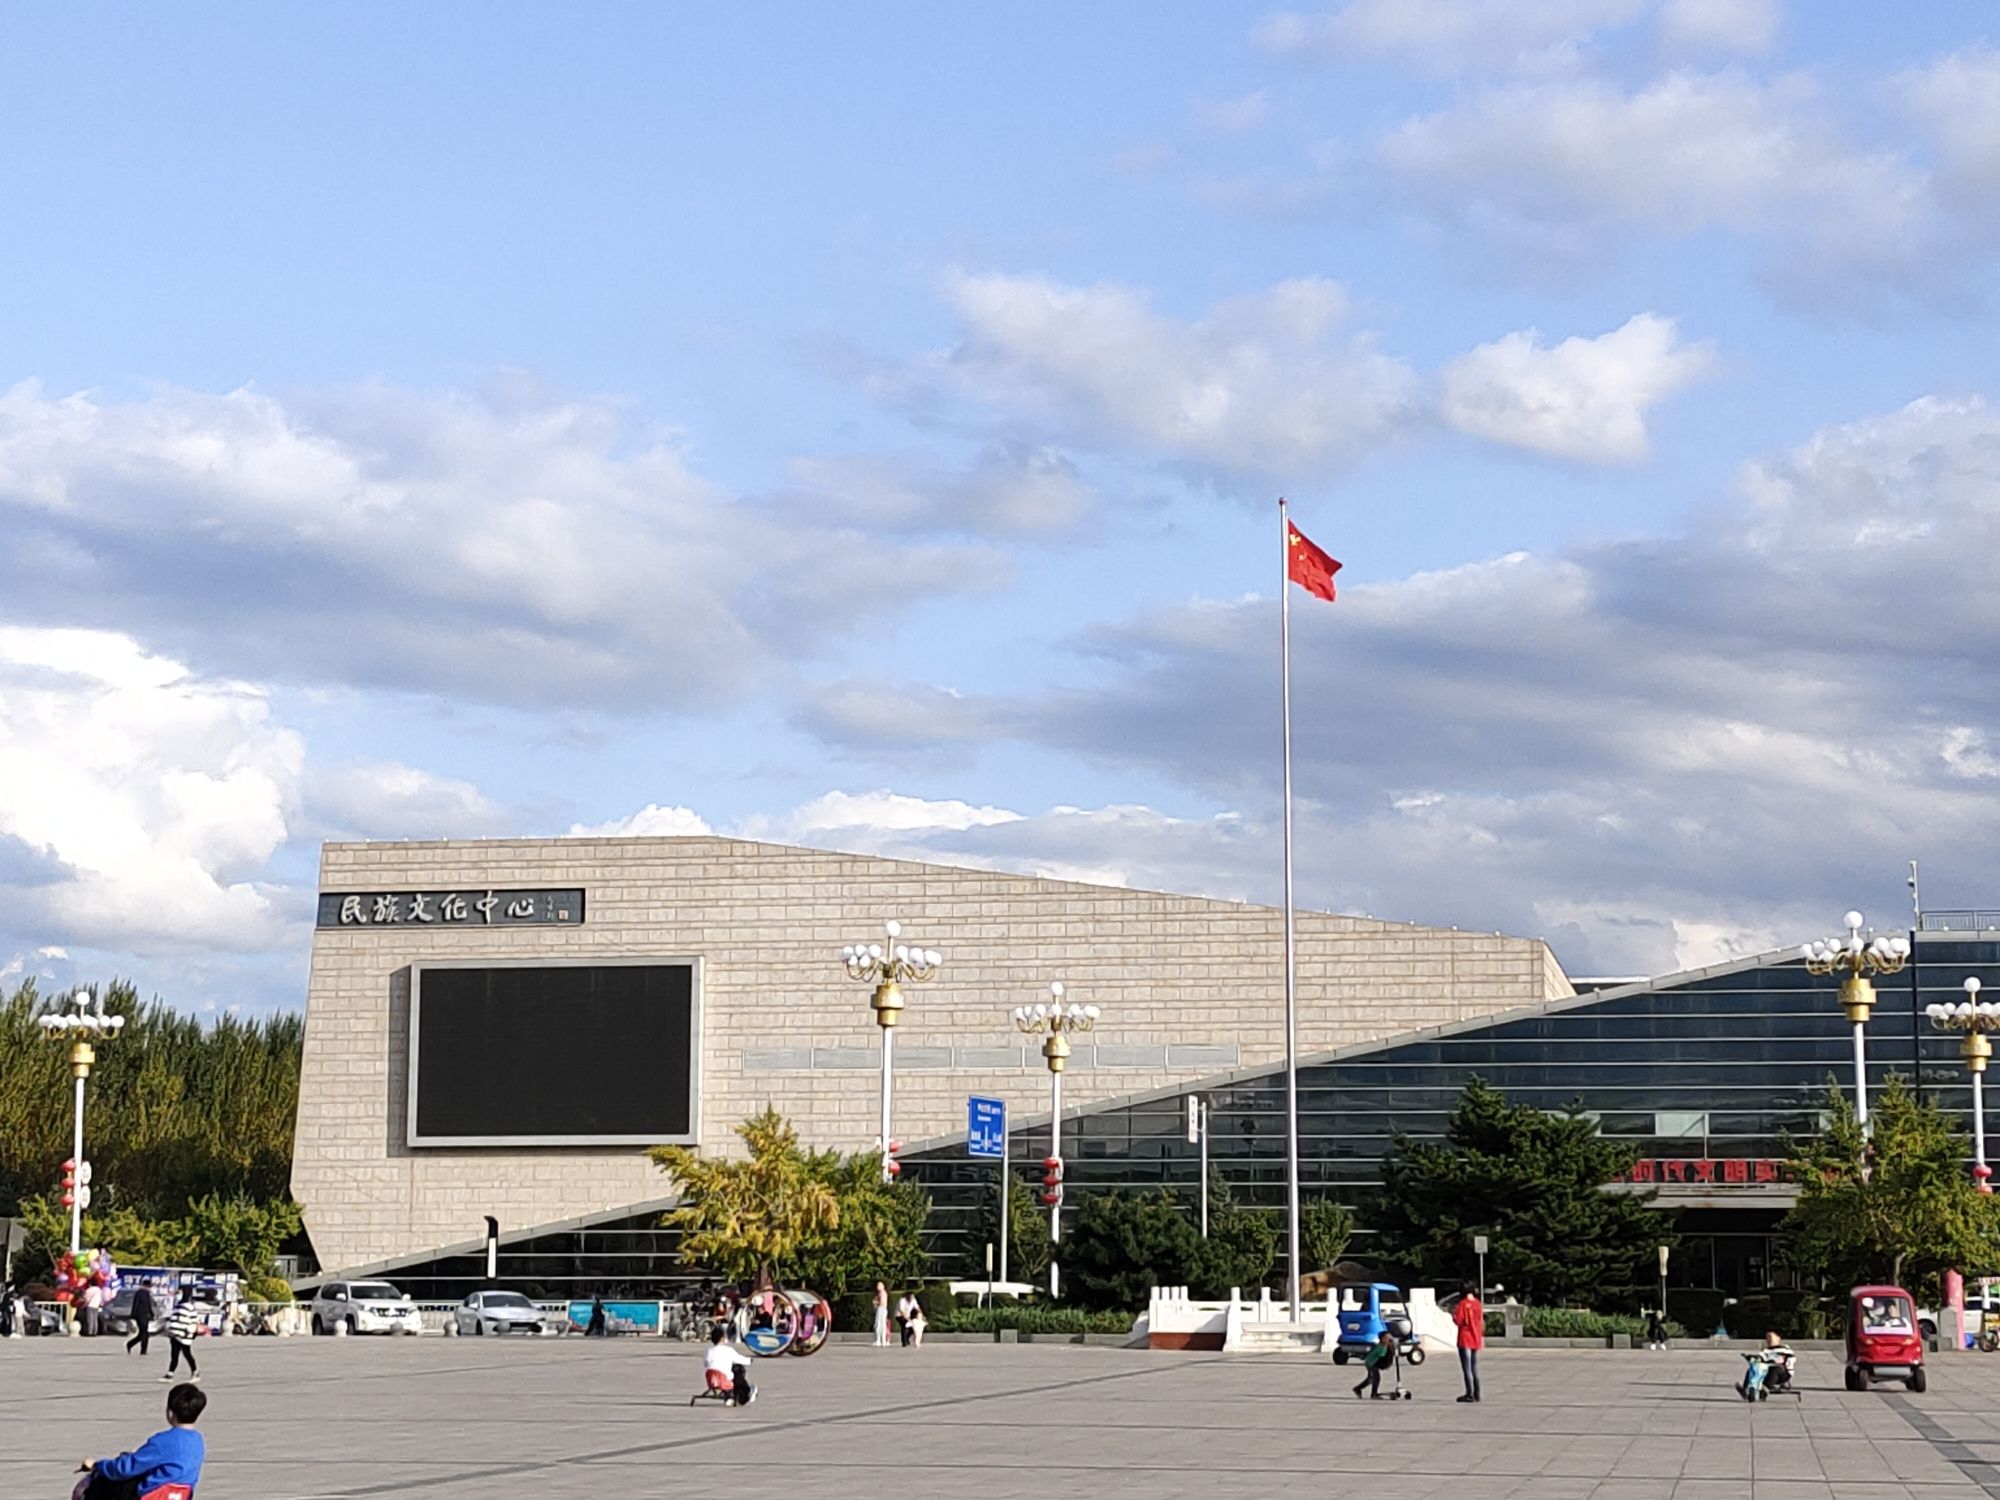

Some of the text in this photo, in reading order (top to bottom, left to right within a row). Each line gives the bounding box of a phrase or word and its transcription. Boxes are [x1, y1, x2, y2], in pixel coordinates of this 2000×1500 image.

[341, 891, 535, 925] 民族文化中心
